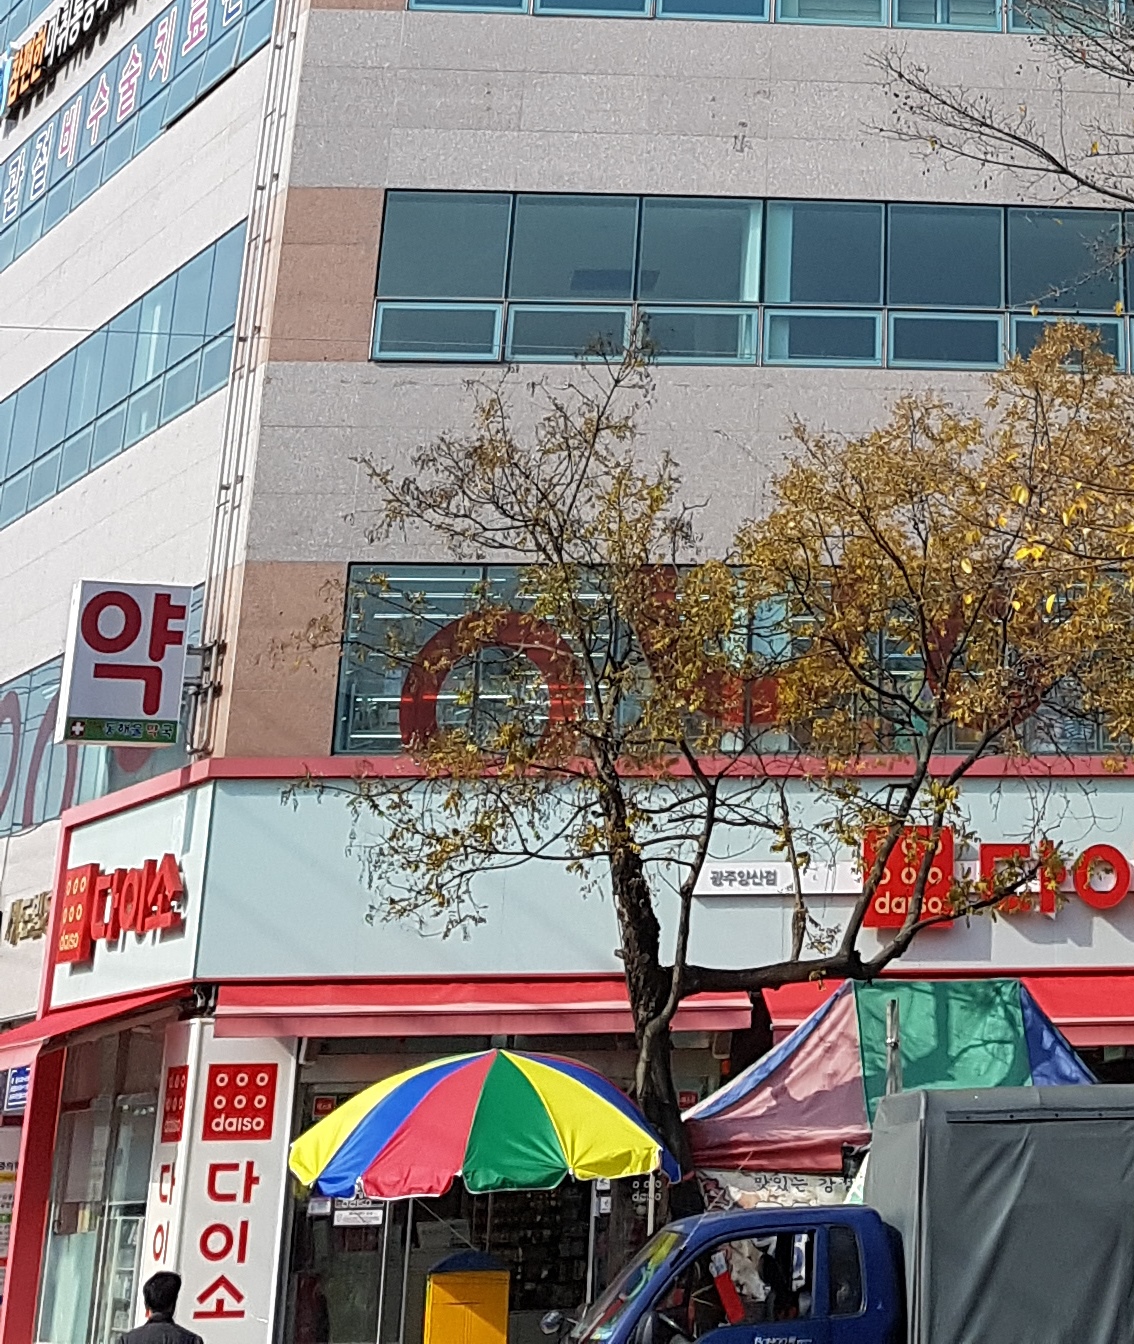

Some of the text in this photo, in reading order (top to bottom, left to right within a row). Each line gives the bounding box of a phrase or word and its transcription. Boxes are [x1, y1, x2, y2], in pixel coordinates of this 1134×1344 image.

[80, 589, 188, 716] 약
[91, 853, 183, 941] 다이소
[710, 869, 777, 887] 광주양산점
[58, 931, 80, 951] daiso
[211, 1113, 265, 1133] daiso
[754, 1174, 808, 1193] 맛있는
[152, 1162, 176, 1265] 다이
[192, 1160, 260, 1320] 다이소
